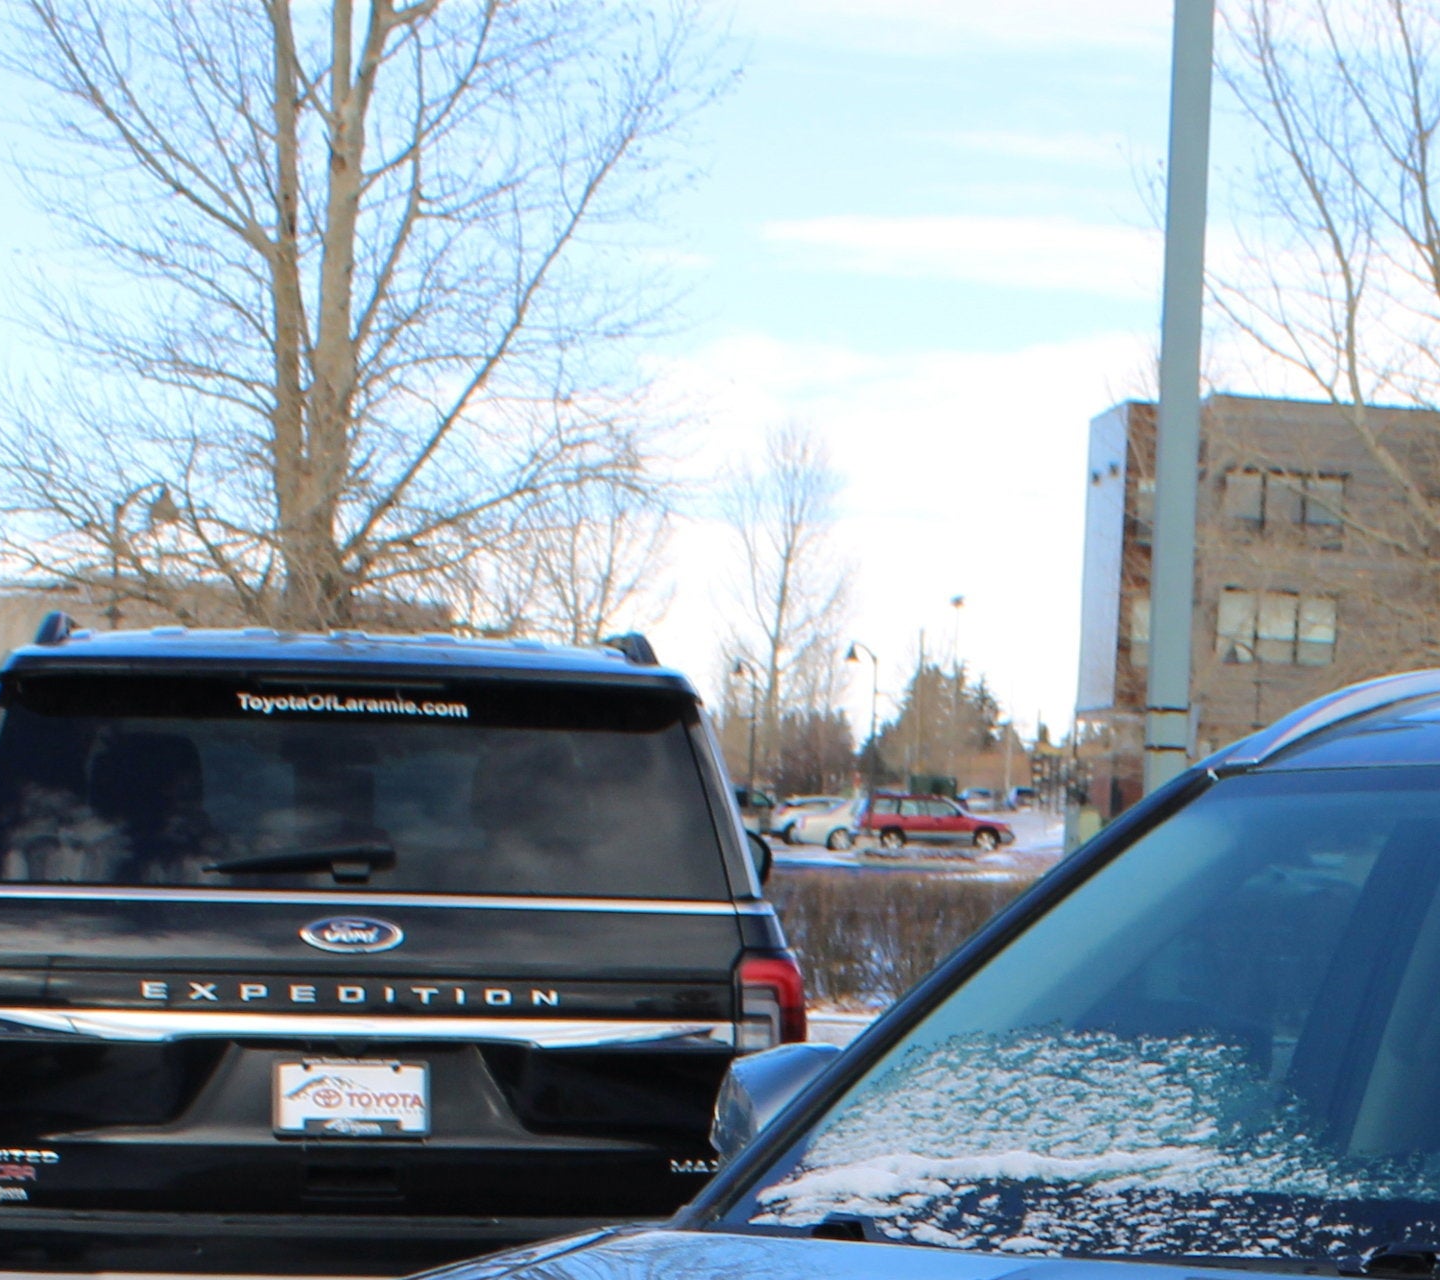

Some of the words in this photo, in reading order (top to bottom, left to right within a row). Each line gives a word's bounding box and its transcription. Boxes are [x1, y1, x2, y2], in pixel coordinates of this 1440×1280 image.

[237, 692, 469, 718] ToyotaOfLaramie.com
[141, 980, 559, 1007] EXPEDITION
[346, 1092, 426, 1109] TOYOTA
